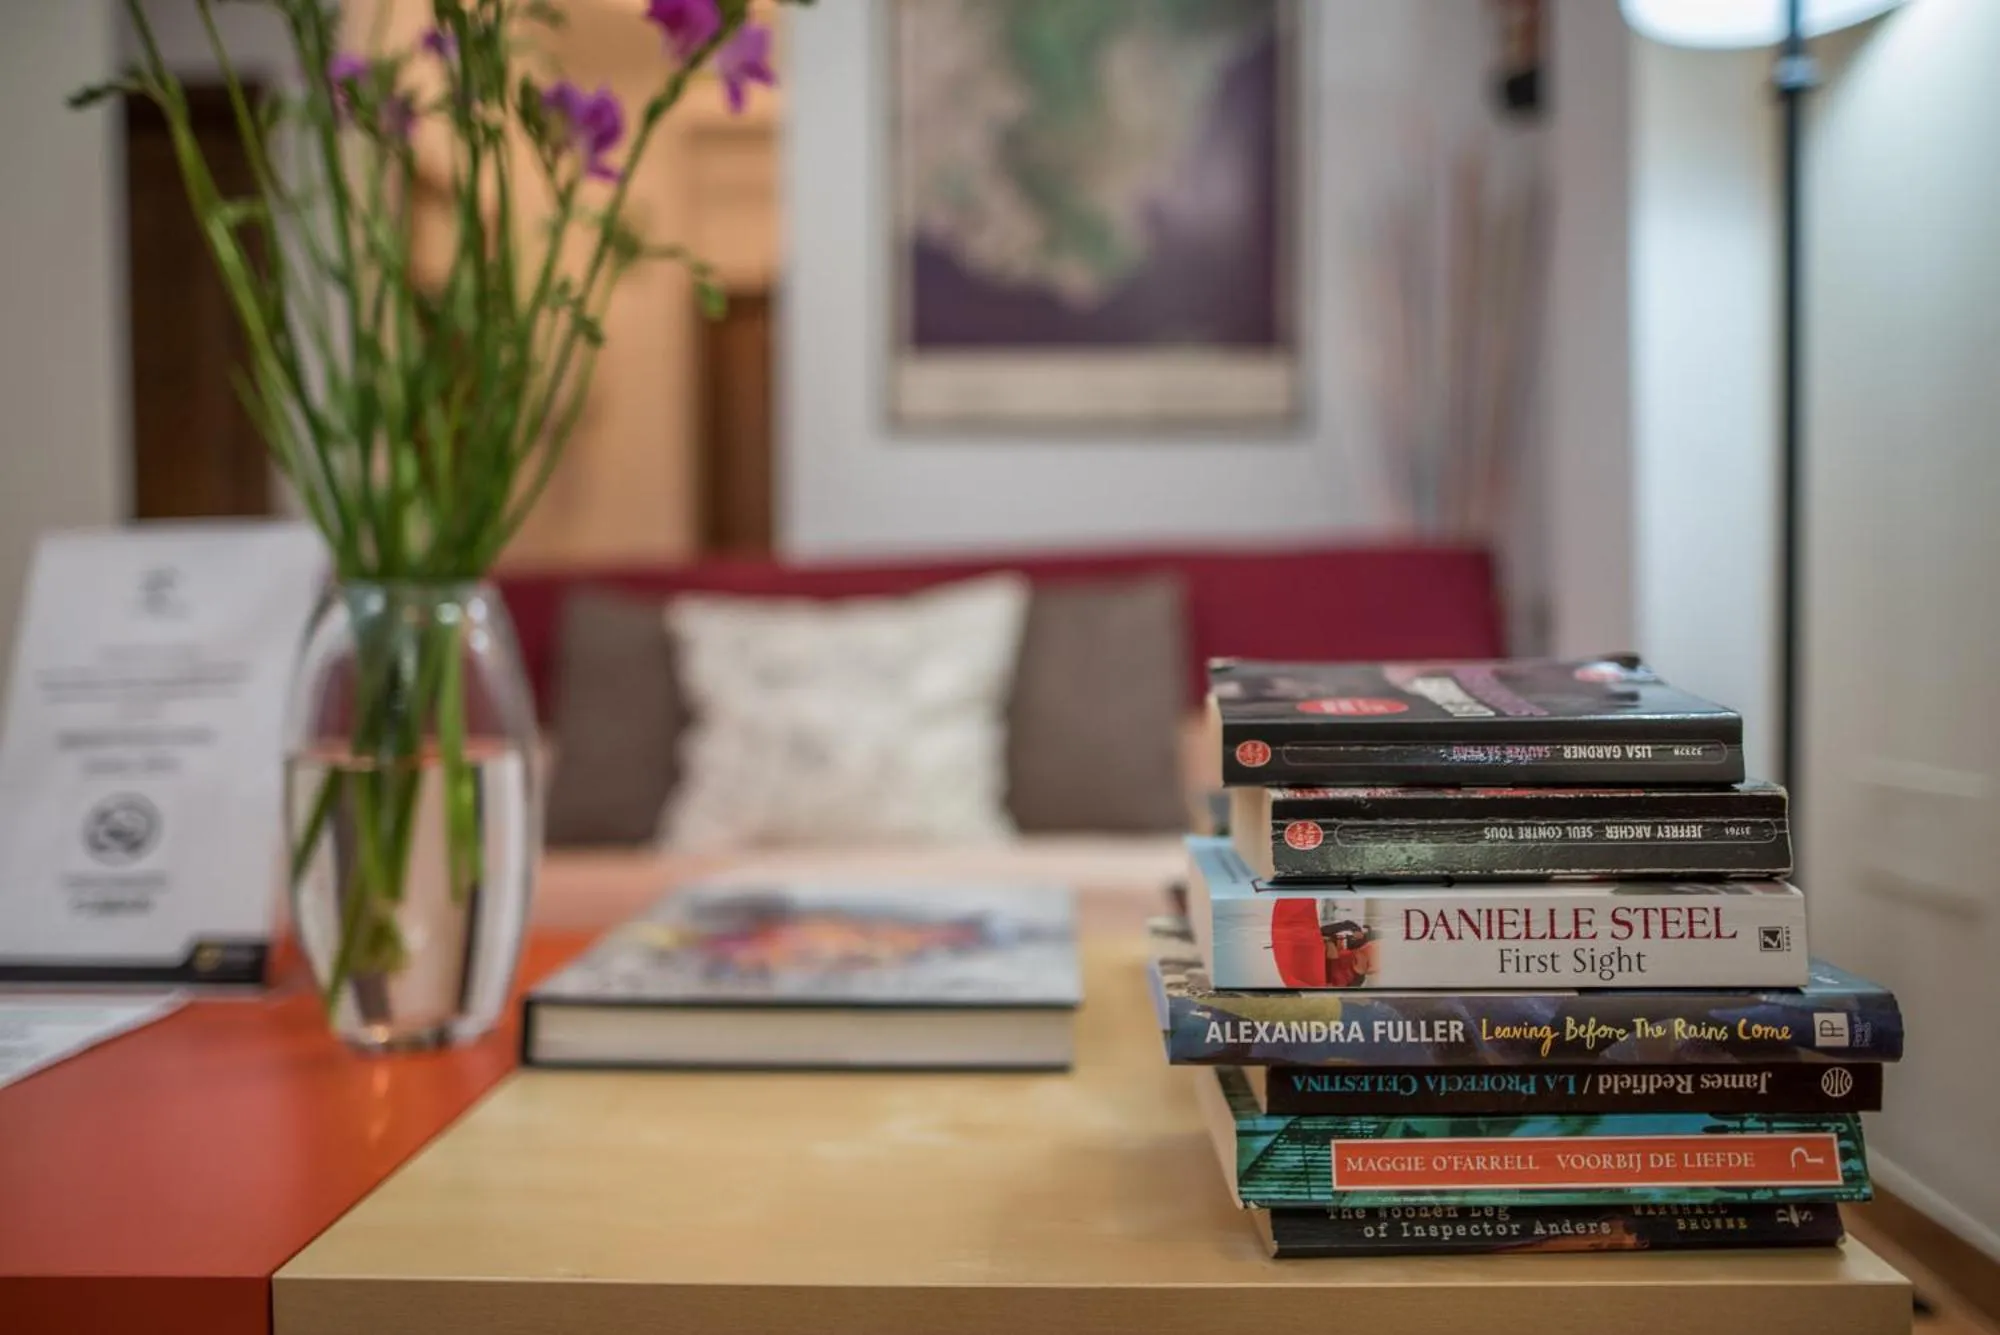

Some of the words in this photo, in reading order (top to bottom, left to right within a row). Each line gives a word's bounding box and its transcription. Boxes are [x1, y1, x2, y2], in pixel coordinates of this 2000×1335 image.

[1626, 744, 1653, 759] LISA
[1484, 826, 1514, 840] TOUS
[1517, 825, 1563, 840] CONTRE
[1566, 825, 1593, 839] SEUL
[1605, 824, 1652, 839] ARCHER
[1656, 824, 1703, 839] JEFFREY
[1403, 907, 1599, 941] DANIELLE
[1610, 906, 1739, 940] STEEL
[1498, 947, 1561, 974] First
[1573, 946, 1648, 981] Sight
[1205, 1020, 1365, 1044] ALEXANDRA
[1373, 1020, 1465, 1043] FULLER
[1481, 1018, 1560, 1057] Leaving
[1564, 1016, 1629, 1050] Before
[1632, 1018, 1667, 1041] The
[1673, 1018, 1730, 1041] Rains
[1737, 1018, 1792, 1041] Come
[1292, 1074, 1418, 1095] CELESTINA
[1425, 1074, 1537, 1096] PROFECÍA
[1544, 1074, 1577, 1095] LA
[1597, 1073, 1695, 1095] Redfield
[1700, 1072, 1773, 1095] James
[1346, 1154, 1425, 1173] MAGGIE
[1432, 1153, 1540, 1172] O'FARRELL
[1557, 1152, 1642, 1174] VOORBIJ
[1649, 1152, 1678, 1169] DE
[1683, 1151, 1755, 1169] LIEFDE
[1326, 1204, 1366, 1220] The
[1470, 1203, 1511, 1222] Leg
[1363, 1222, 1388, 1238] of
[1401, 1221, 1521, 1241] Inspector
[1533, 1219, 1613, 1236] Anders
[1676, 1217, 1748, 1231] BROWNE
